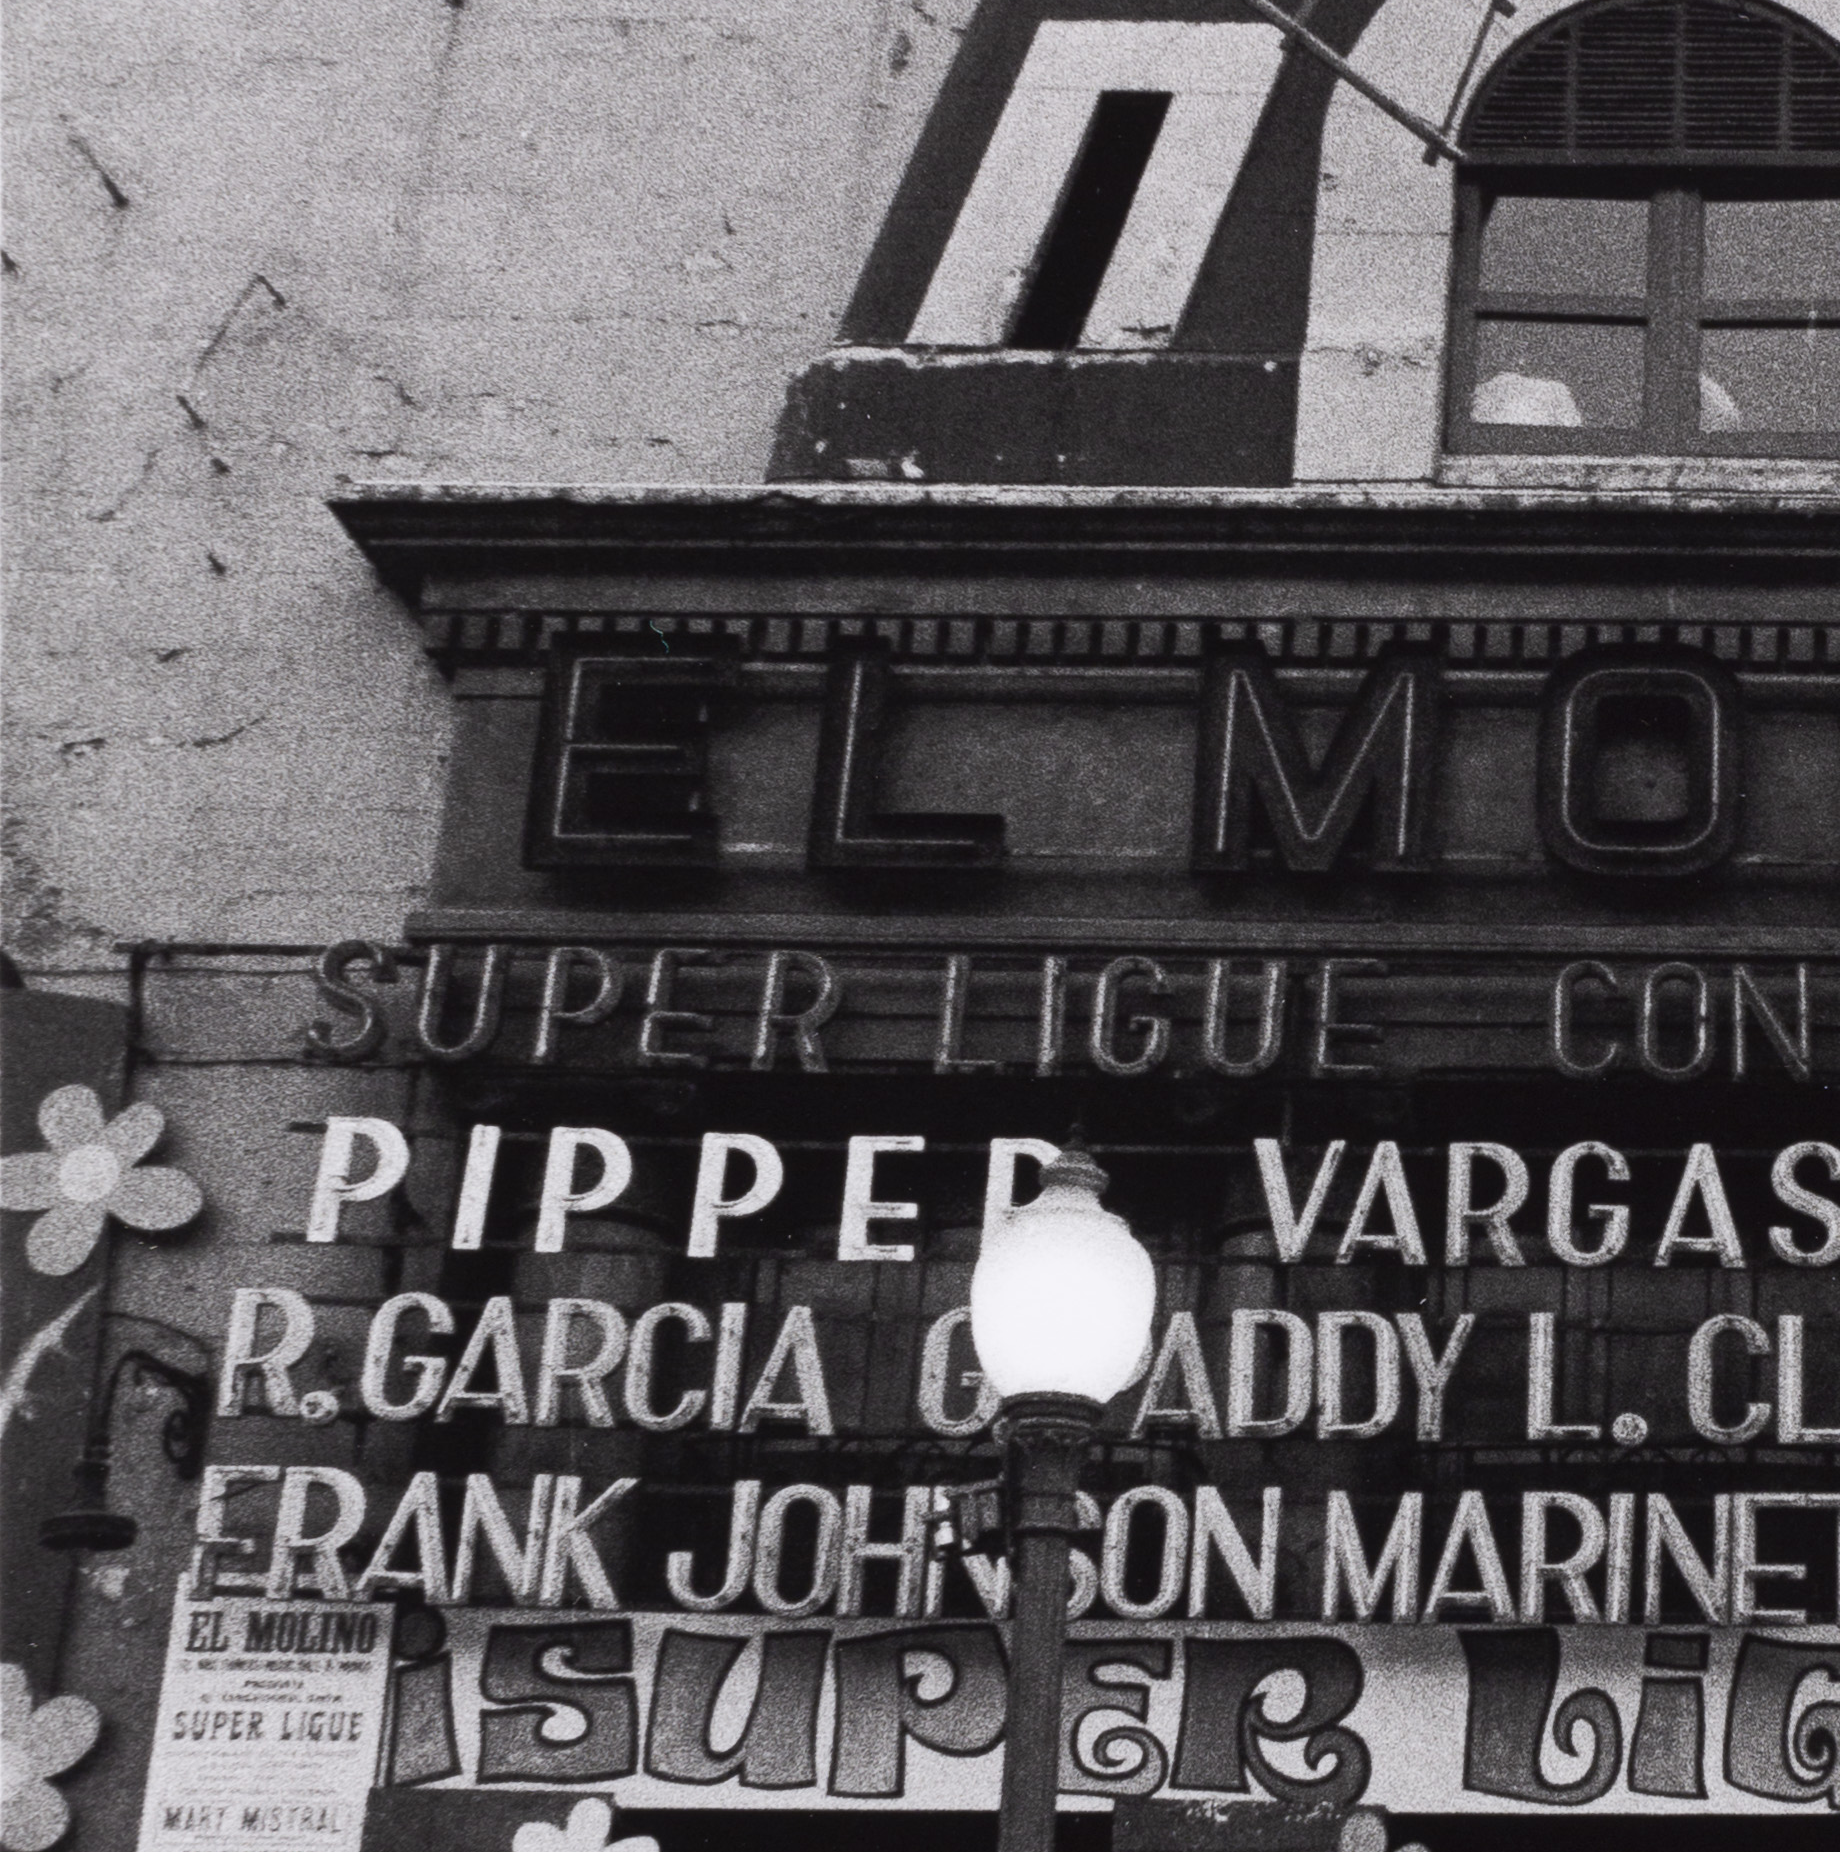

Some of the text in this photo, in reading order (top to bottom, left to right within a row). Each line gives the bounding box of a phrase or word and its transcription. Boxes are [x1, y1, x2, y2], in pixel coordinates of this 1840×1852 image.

[522, 633, 1004, 872] EL
[305, 940, 832, 1075] SUPER
[933, 955, 1387, 1079] LIGUE
[1550, 961, 1810, 1083] CON
[188, 1464, 641, 1606] FRANK
[185, 1611, 378, 1654] EL MOLINO
[173, 1711, 363, 1741] SUPER LIGUE
[163, 1806, 342, 1834] MARY MISTRAL
